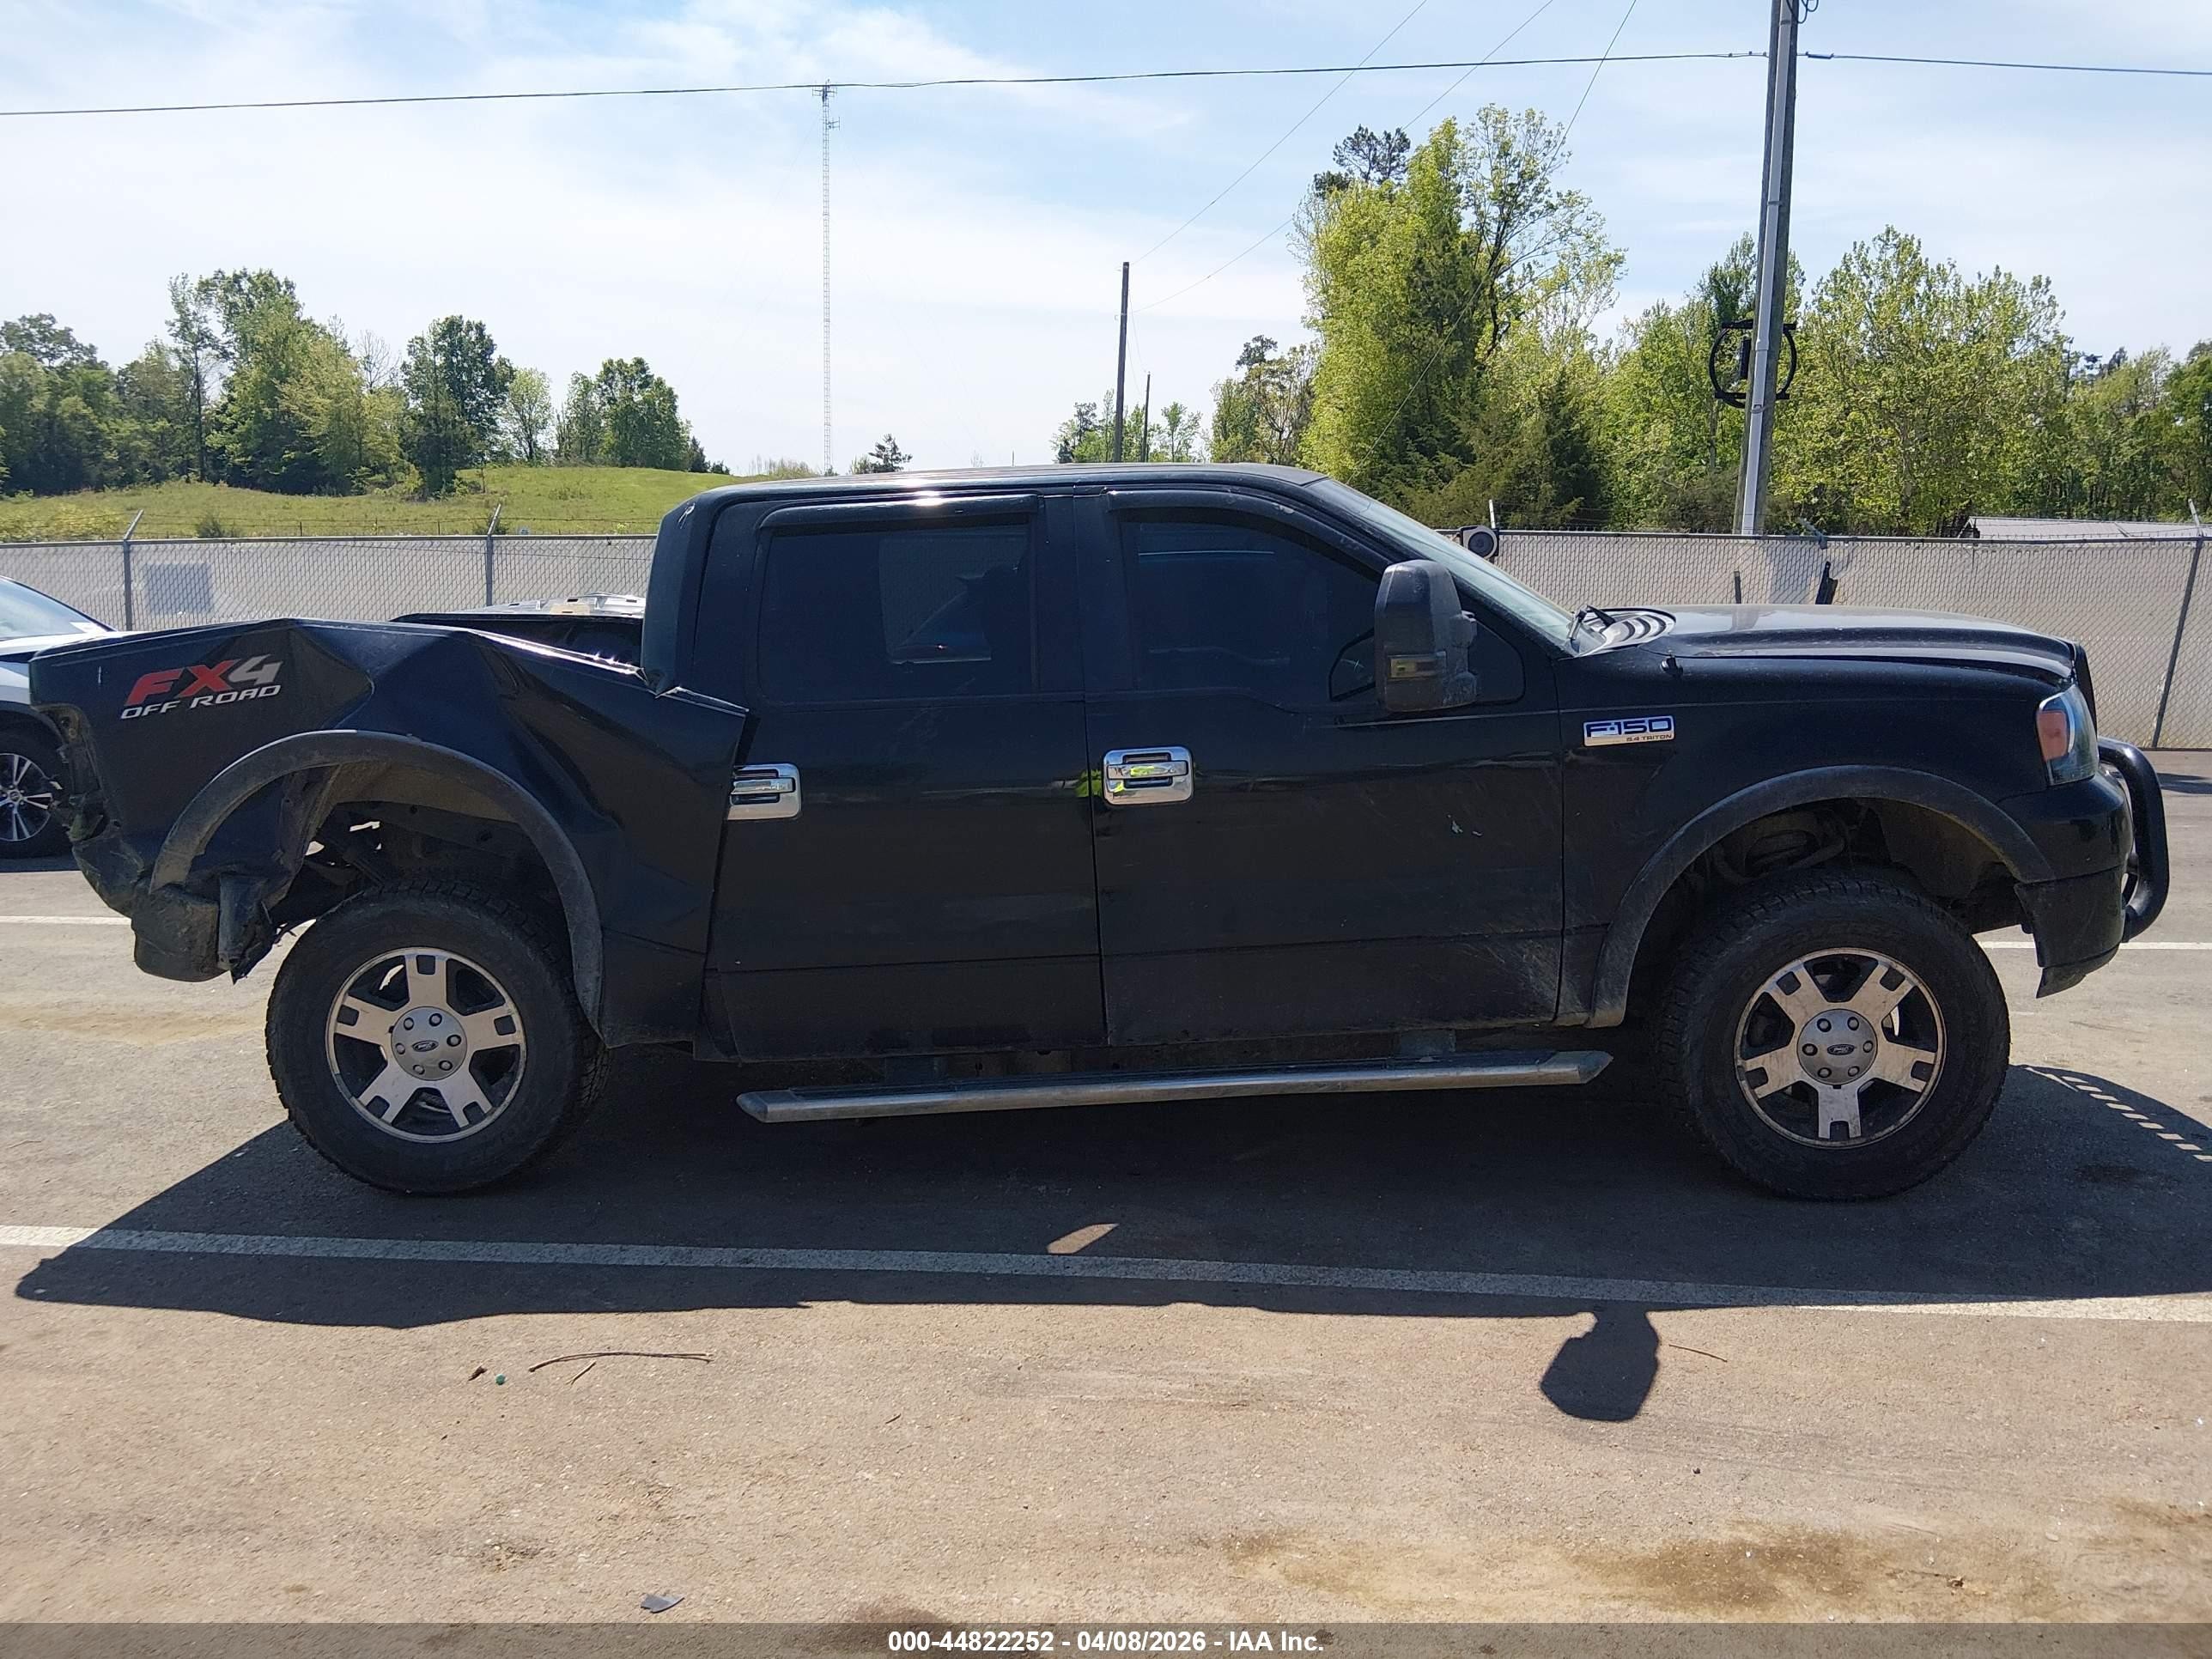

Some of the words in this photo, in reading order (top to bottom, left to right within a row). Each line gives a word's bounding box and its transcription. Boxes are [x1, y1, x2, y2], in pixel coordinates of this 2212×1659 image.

[125, 654, 283, 707] FX4
[121, 700, 180, 720] OFF
[190, 684, 282, 708] ROAD
[1586, 717, 1672, 738] F-150
